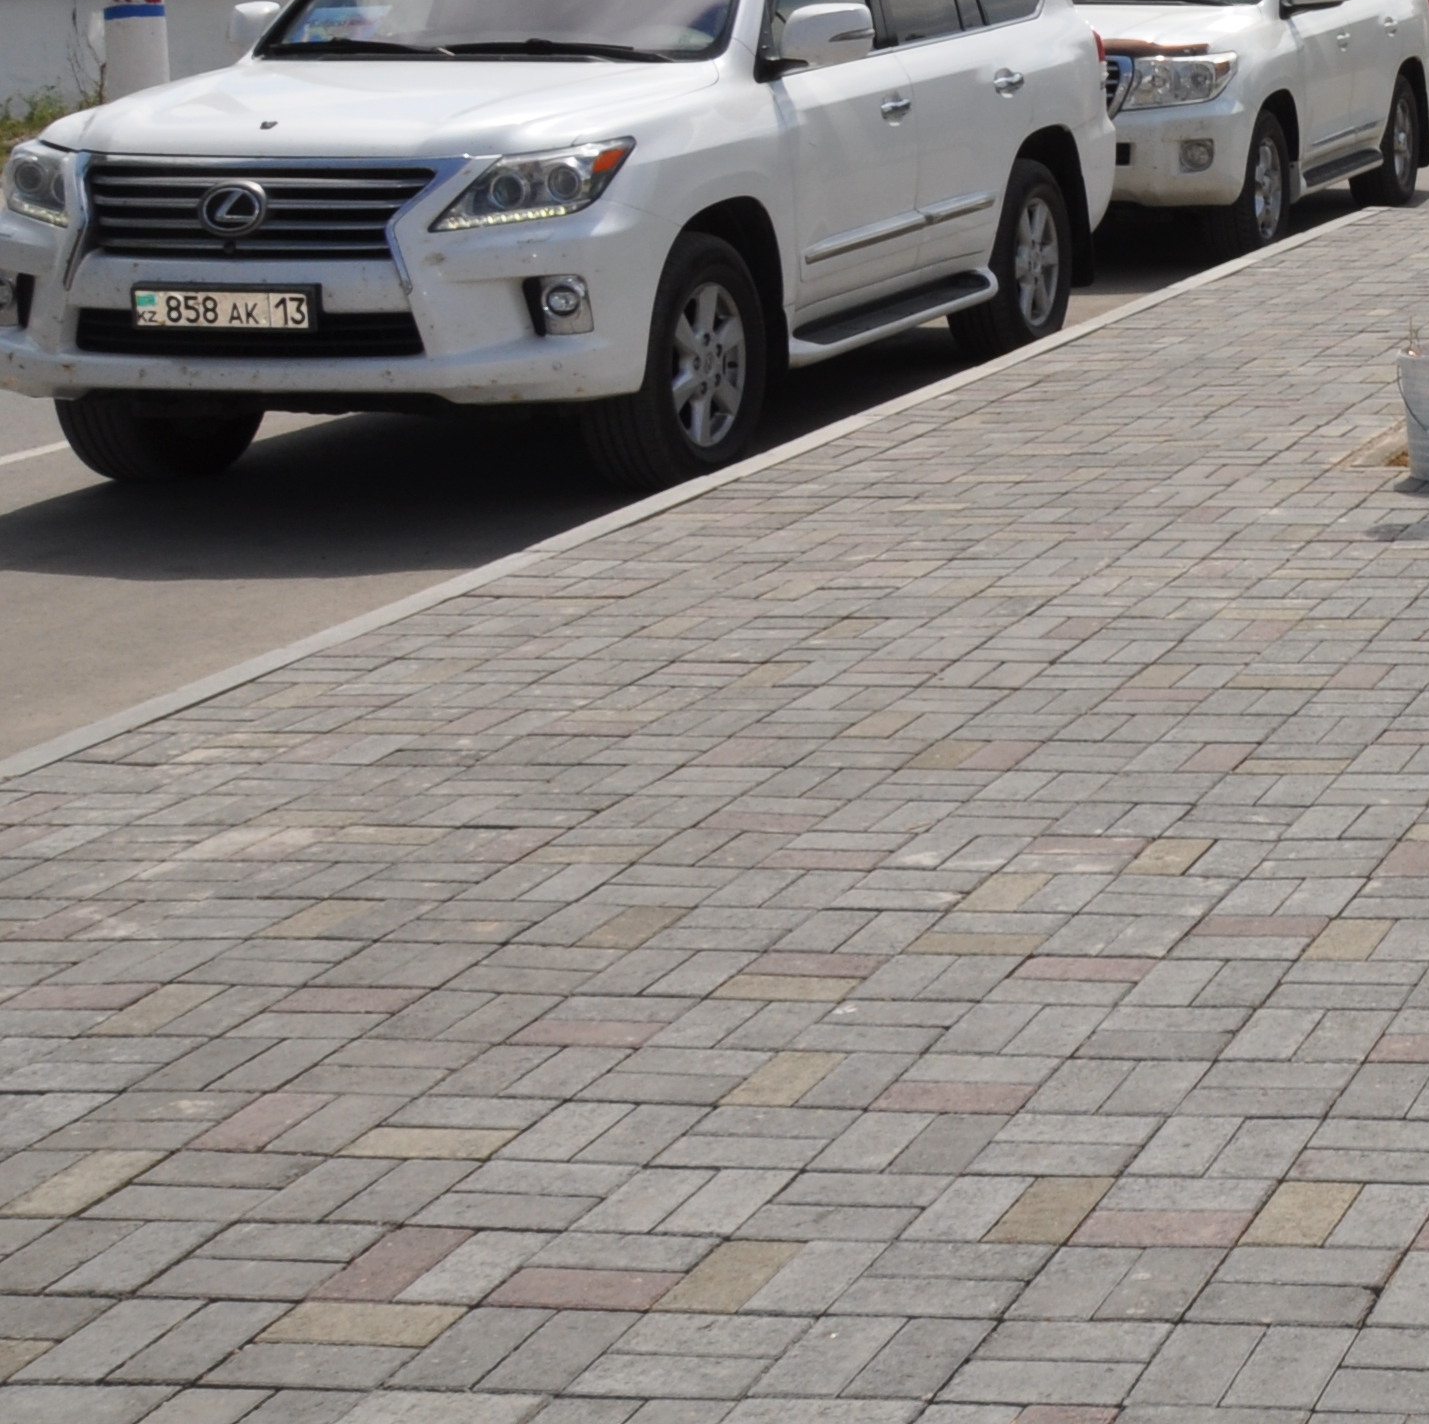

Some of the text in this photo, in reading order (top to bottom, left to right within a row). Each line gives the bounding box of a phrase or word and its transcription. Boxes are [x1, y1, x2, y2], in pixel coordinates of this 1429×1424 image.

[137, 295, 306, 326] KZ 858 AK 13
